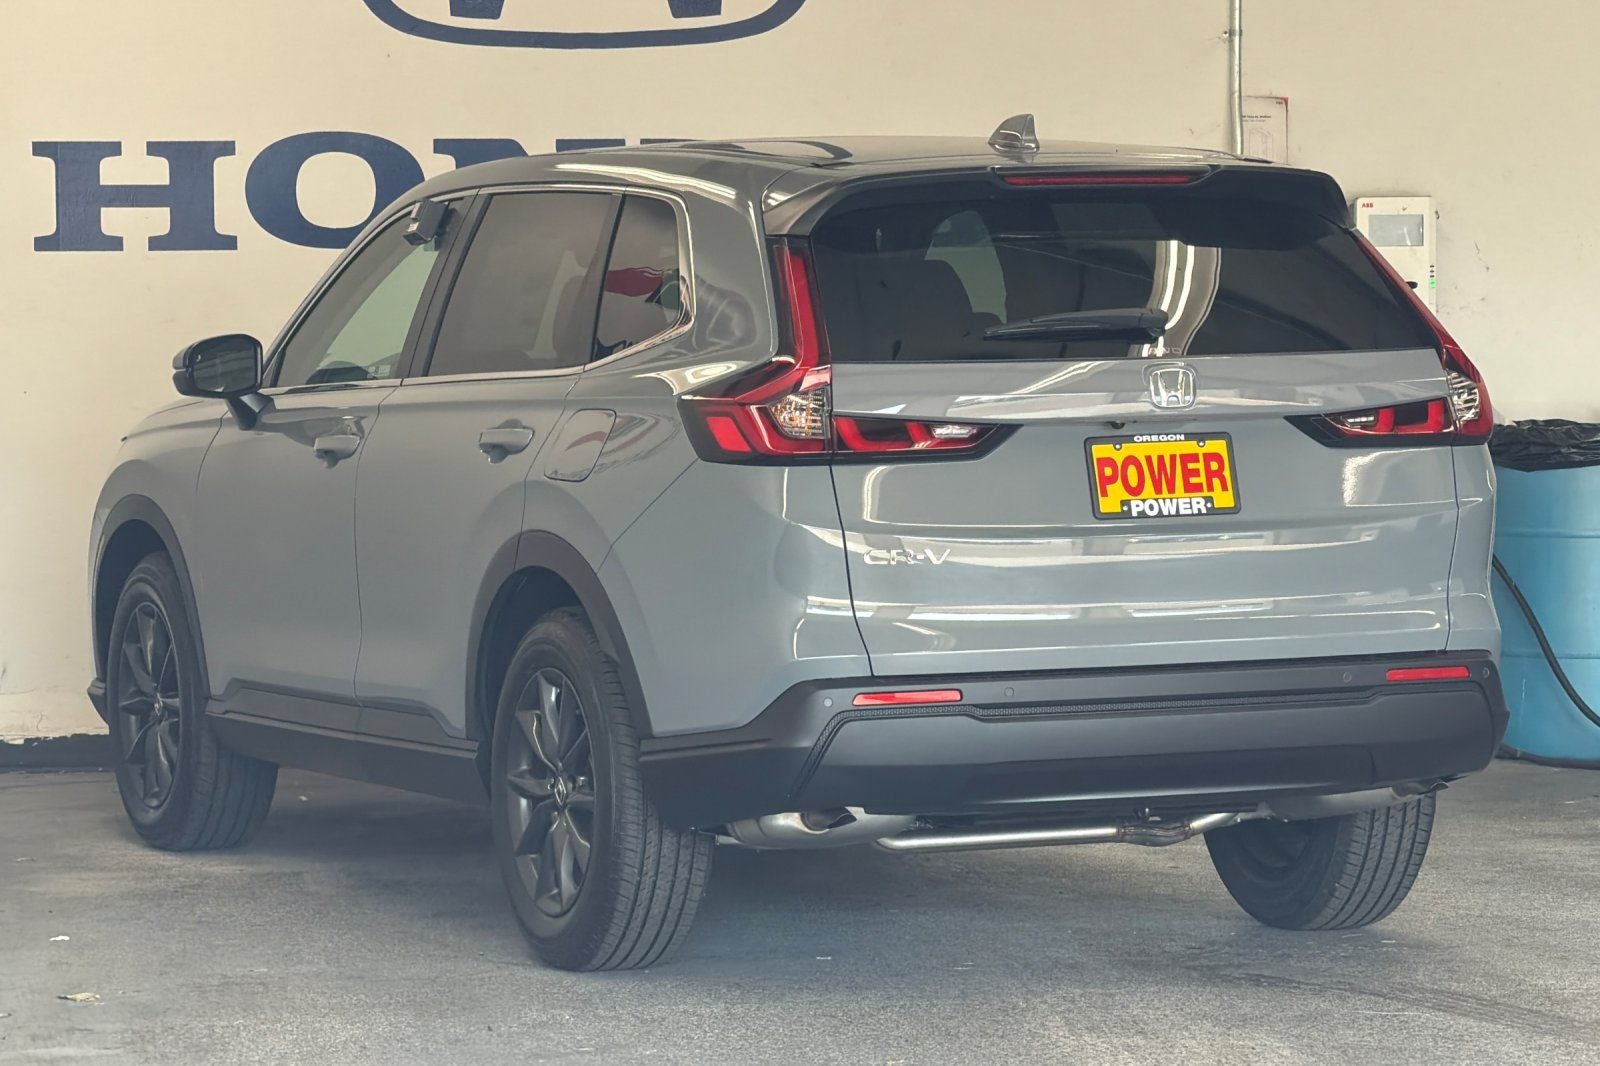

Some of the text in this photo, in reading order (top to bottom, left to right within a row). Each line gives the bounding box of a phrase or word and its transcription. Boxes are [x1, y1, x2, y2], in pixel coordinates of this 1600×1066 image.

[1133, 434, 1185, 442] OREGON
[1096, 452, 1229, 498] POWER
[1130, 498, 1207, 517] POWER
[863, 548, 951, 565] CR-V
